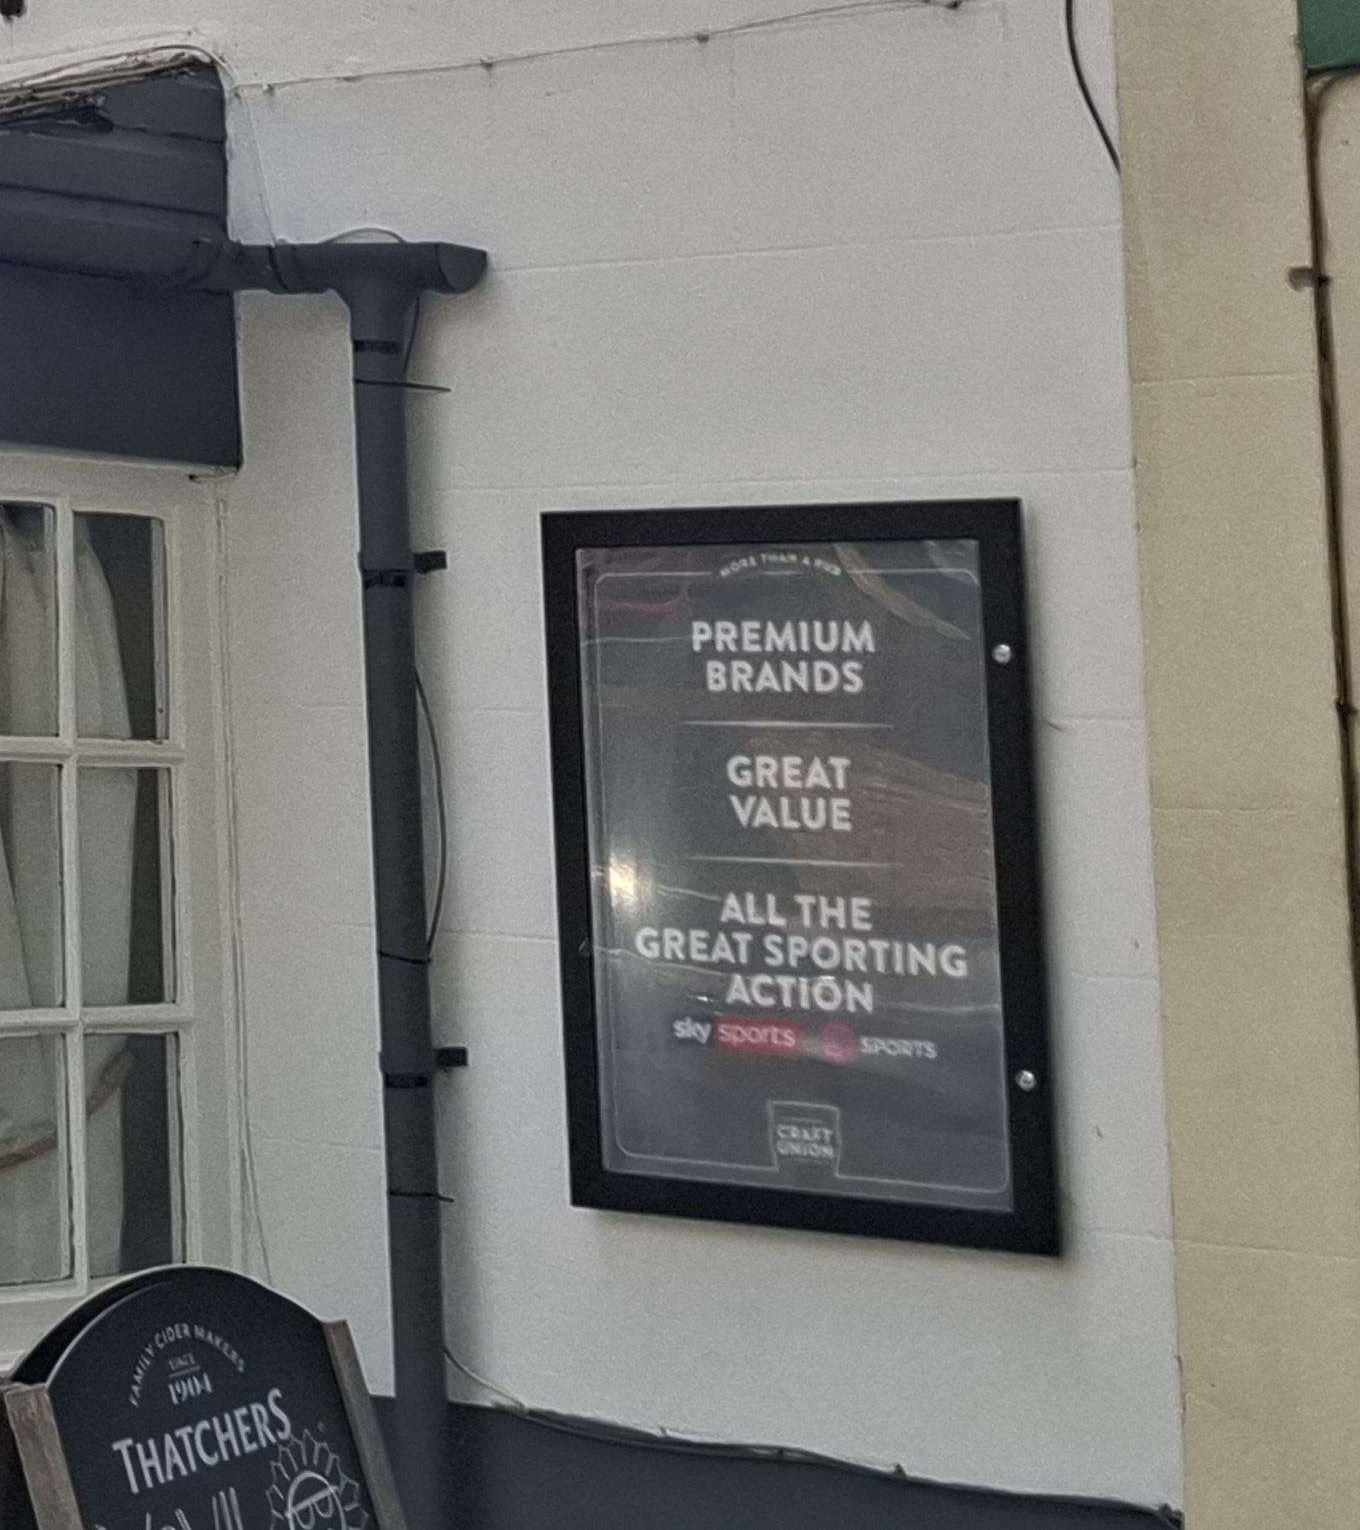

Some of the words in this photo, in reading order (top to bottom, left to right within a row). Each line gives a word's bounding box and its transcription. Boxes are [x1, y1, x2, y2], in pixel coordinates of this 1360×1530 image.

[691, 619, 876, 654] PREMIUM
[706, 659, 864, 694] BRANDS
[725, 754, 852, 791] GREAT
[729, 794, 853, 833] VALUE
[719, 891, 788, 928] ALL
[794, 893, 874, 932] THE
[634, 926, 754, 965] GREAT
[763, 932, 969, 978] SPORTING
[724, 974, 875, 1014] ACTION
[672, 1016, 712, 1045] sky
[717, 1023, 797, 1048] sports
[859, 1035, 939, 1060] SPORTS
[128, 1343, 155, 1408] FAMILY
[154, 1322, 192, 1350] CIDER
[111, 1386, 292, 1496] THATCHERS
